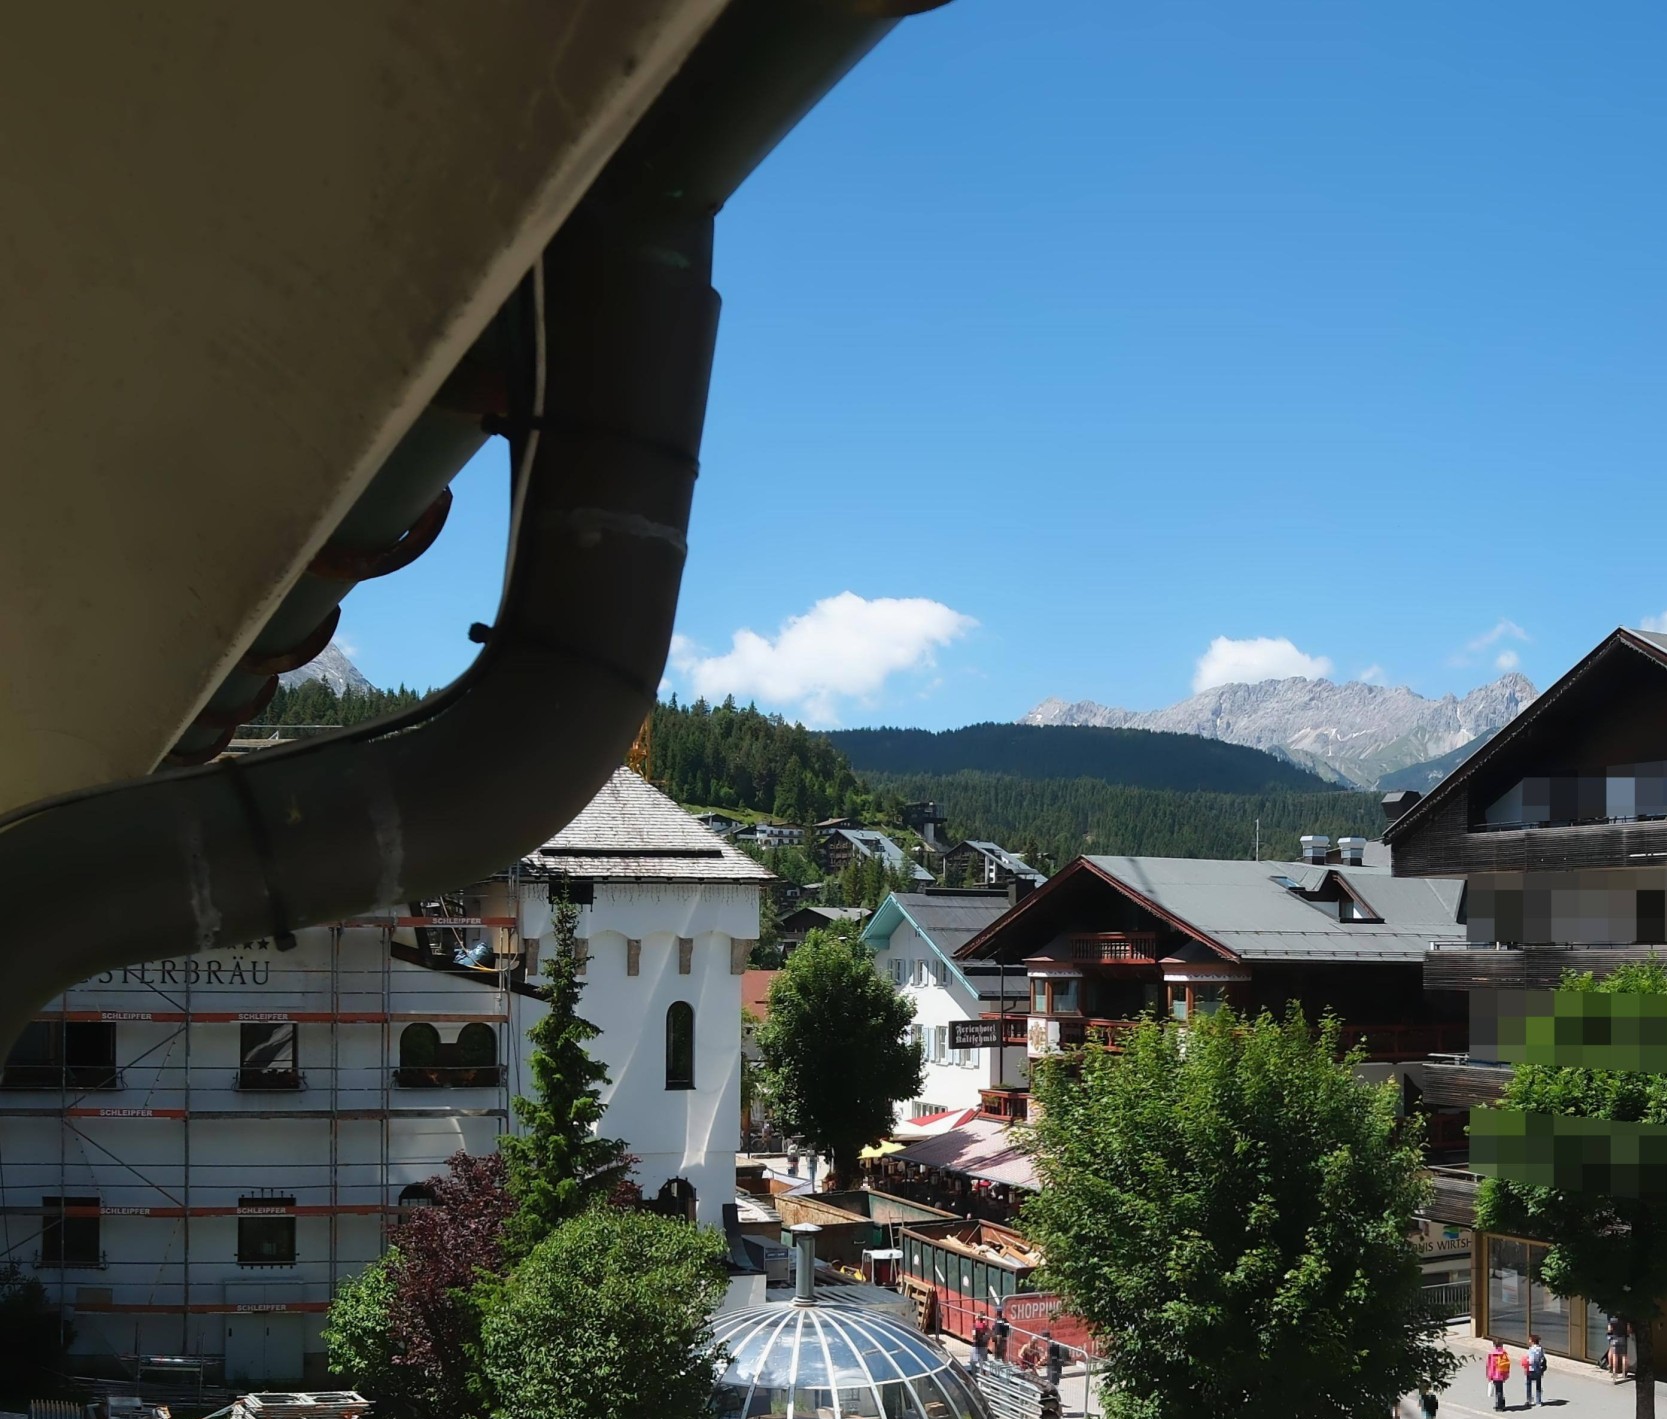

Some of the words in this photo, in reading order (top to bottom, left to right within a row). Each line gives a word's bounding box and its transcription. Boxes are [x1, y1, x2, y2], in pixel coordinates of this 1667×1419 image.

[432, 917, 482, 925] SCHLEIPFER
[80, 956, 272, 986] STERBRÄU
[101, 1012, 152, 1021] SCHLEIPFER
[238, 1012, 288, 1021] SCHLEIPFER
[100, 1109, 152, 1117] SCHLEIPFER
